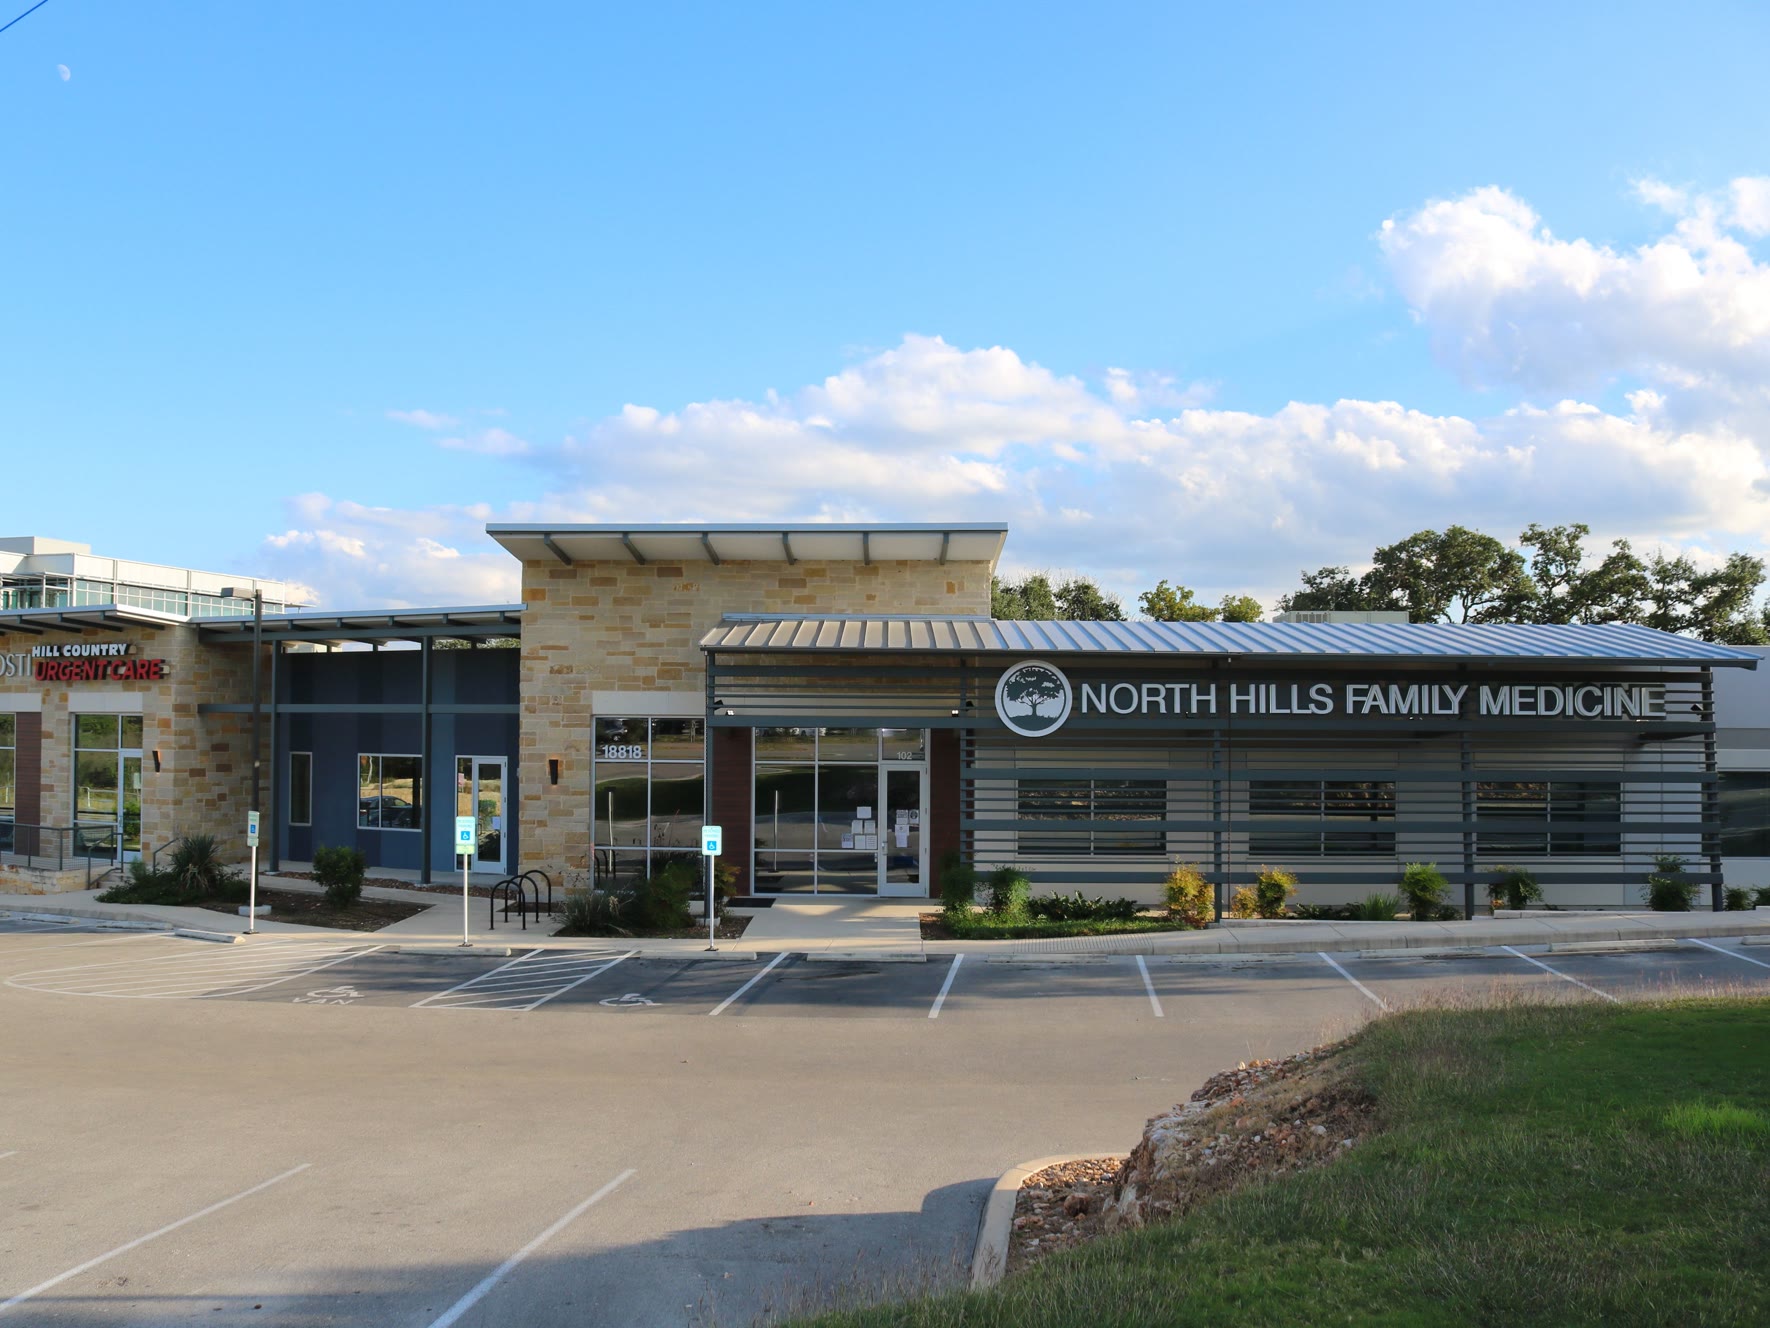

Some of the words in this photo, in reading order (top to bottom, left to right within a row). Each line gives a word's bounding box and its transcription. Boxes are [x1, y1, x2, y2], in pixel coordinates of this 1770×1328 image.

[31, 645, 60, 658] HILL
[62, 643, 128, 657] COUNTRY
[34, 660, 108, 681] URGENT
[110, 659, 163, 680] CARE
[1081, 683, 1217, 714] NORTH
[1229, 683, 1334, 715] HILLS
[1345, 684, 1469, 715] FAMILY
[1479, 685, 1667, 717] MEDICINE
[602, 744, 642, 759] 18818
[897, 751, 912, 760] 102
[292, 997, 354, 1005] VAN
